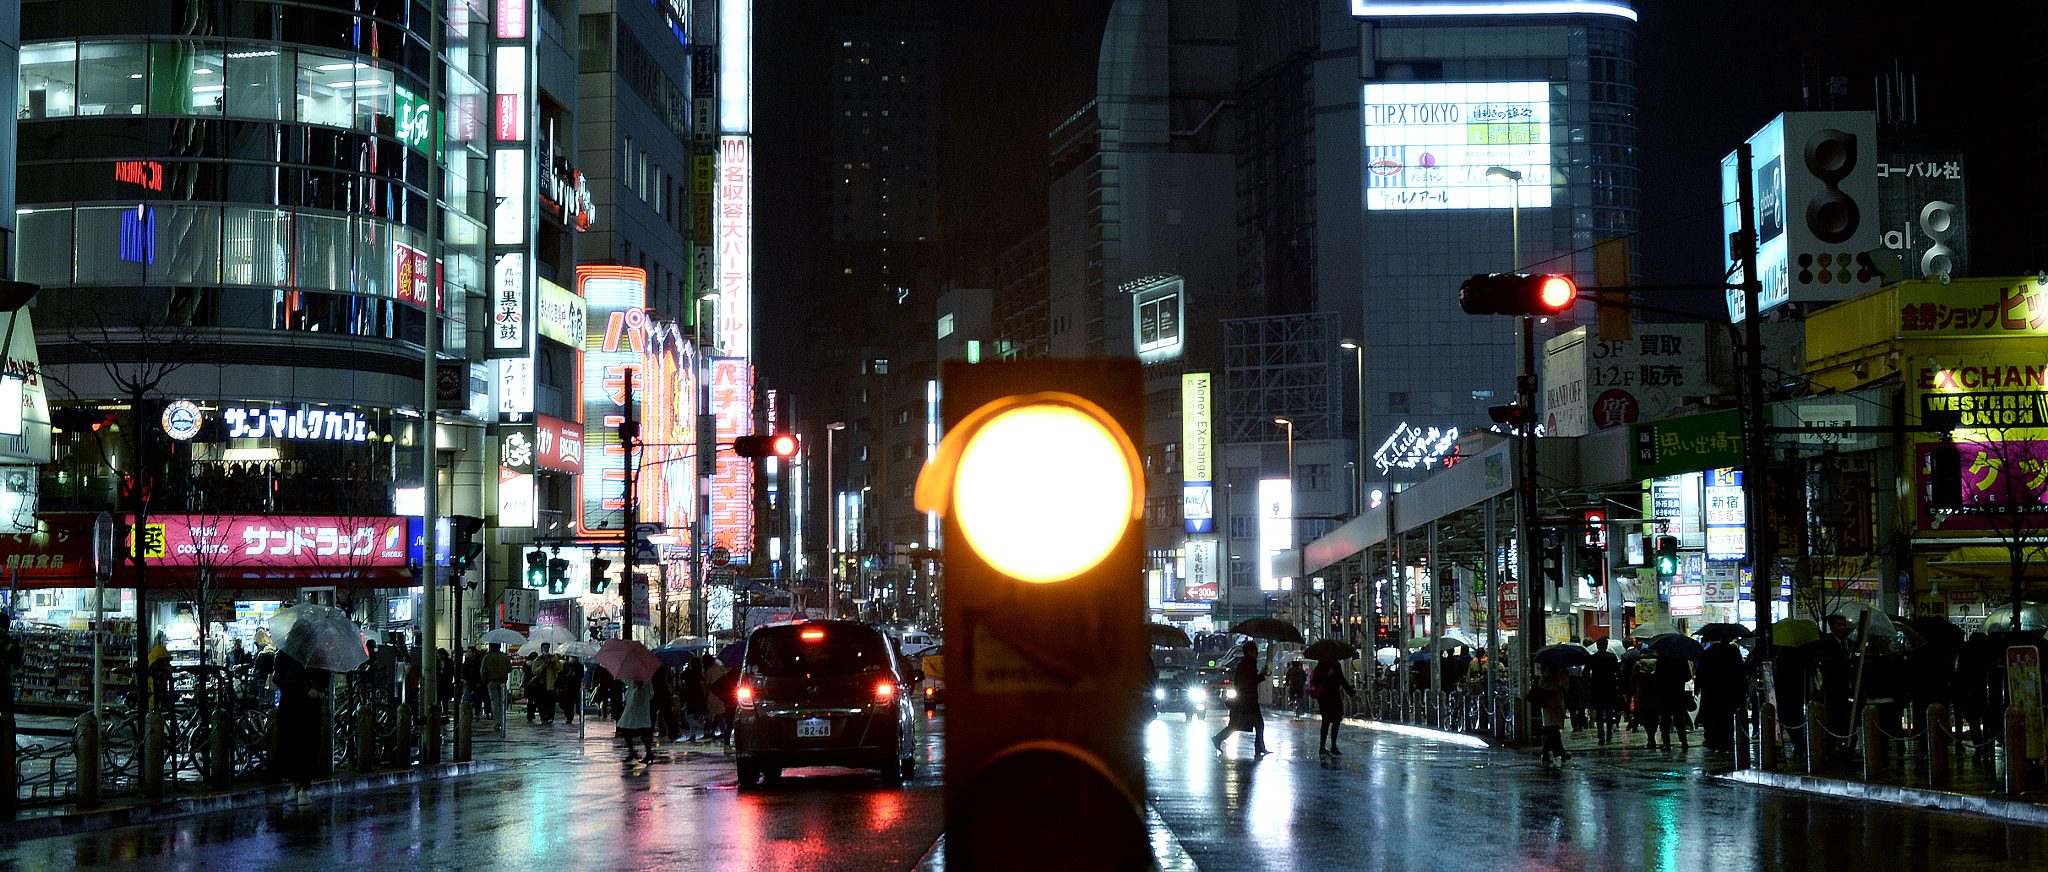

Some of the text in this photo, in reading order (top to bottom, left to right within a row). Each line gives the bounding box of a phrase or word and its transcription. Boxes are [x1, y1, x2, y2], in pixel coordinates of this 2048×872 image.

[1411, 103, 1459, 123] TOKYO
[723, 139, 743, 357] 100名収容大パーティールー
[499, 268, 518, 340] 九州 黒太鼓
[1901, 302, 2000, 331] 金券ショップ
[1640, 334, 1682, 357] 買取
[1640, 364, 1684, 387] 販売
[1196, 379, 1207, 417] Money
[1926, 394, 2034, 411] WESTERN
[224, 407, 367, 442] サンマルクカフェ
[1960, 410, 2034, 426] UNION
[1660, 430, 1742, 457] 思い出横丁
[1711, 495, 1739, 509] 新宿
[188, 526, 218, 538] DRUG
[242, 524, 376, 556] サンドラッグ
[176, 543, 230, 555] COSMETIC
